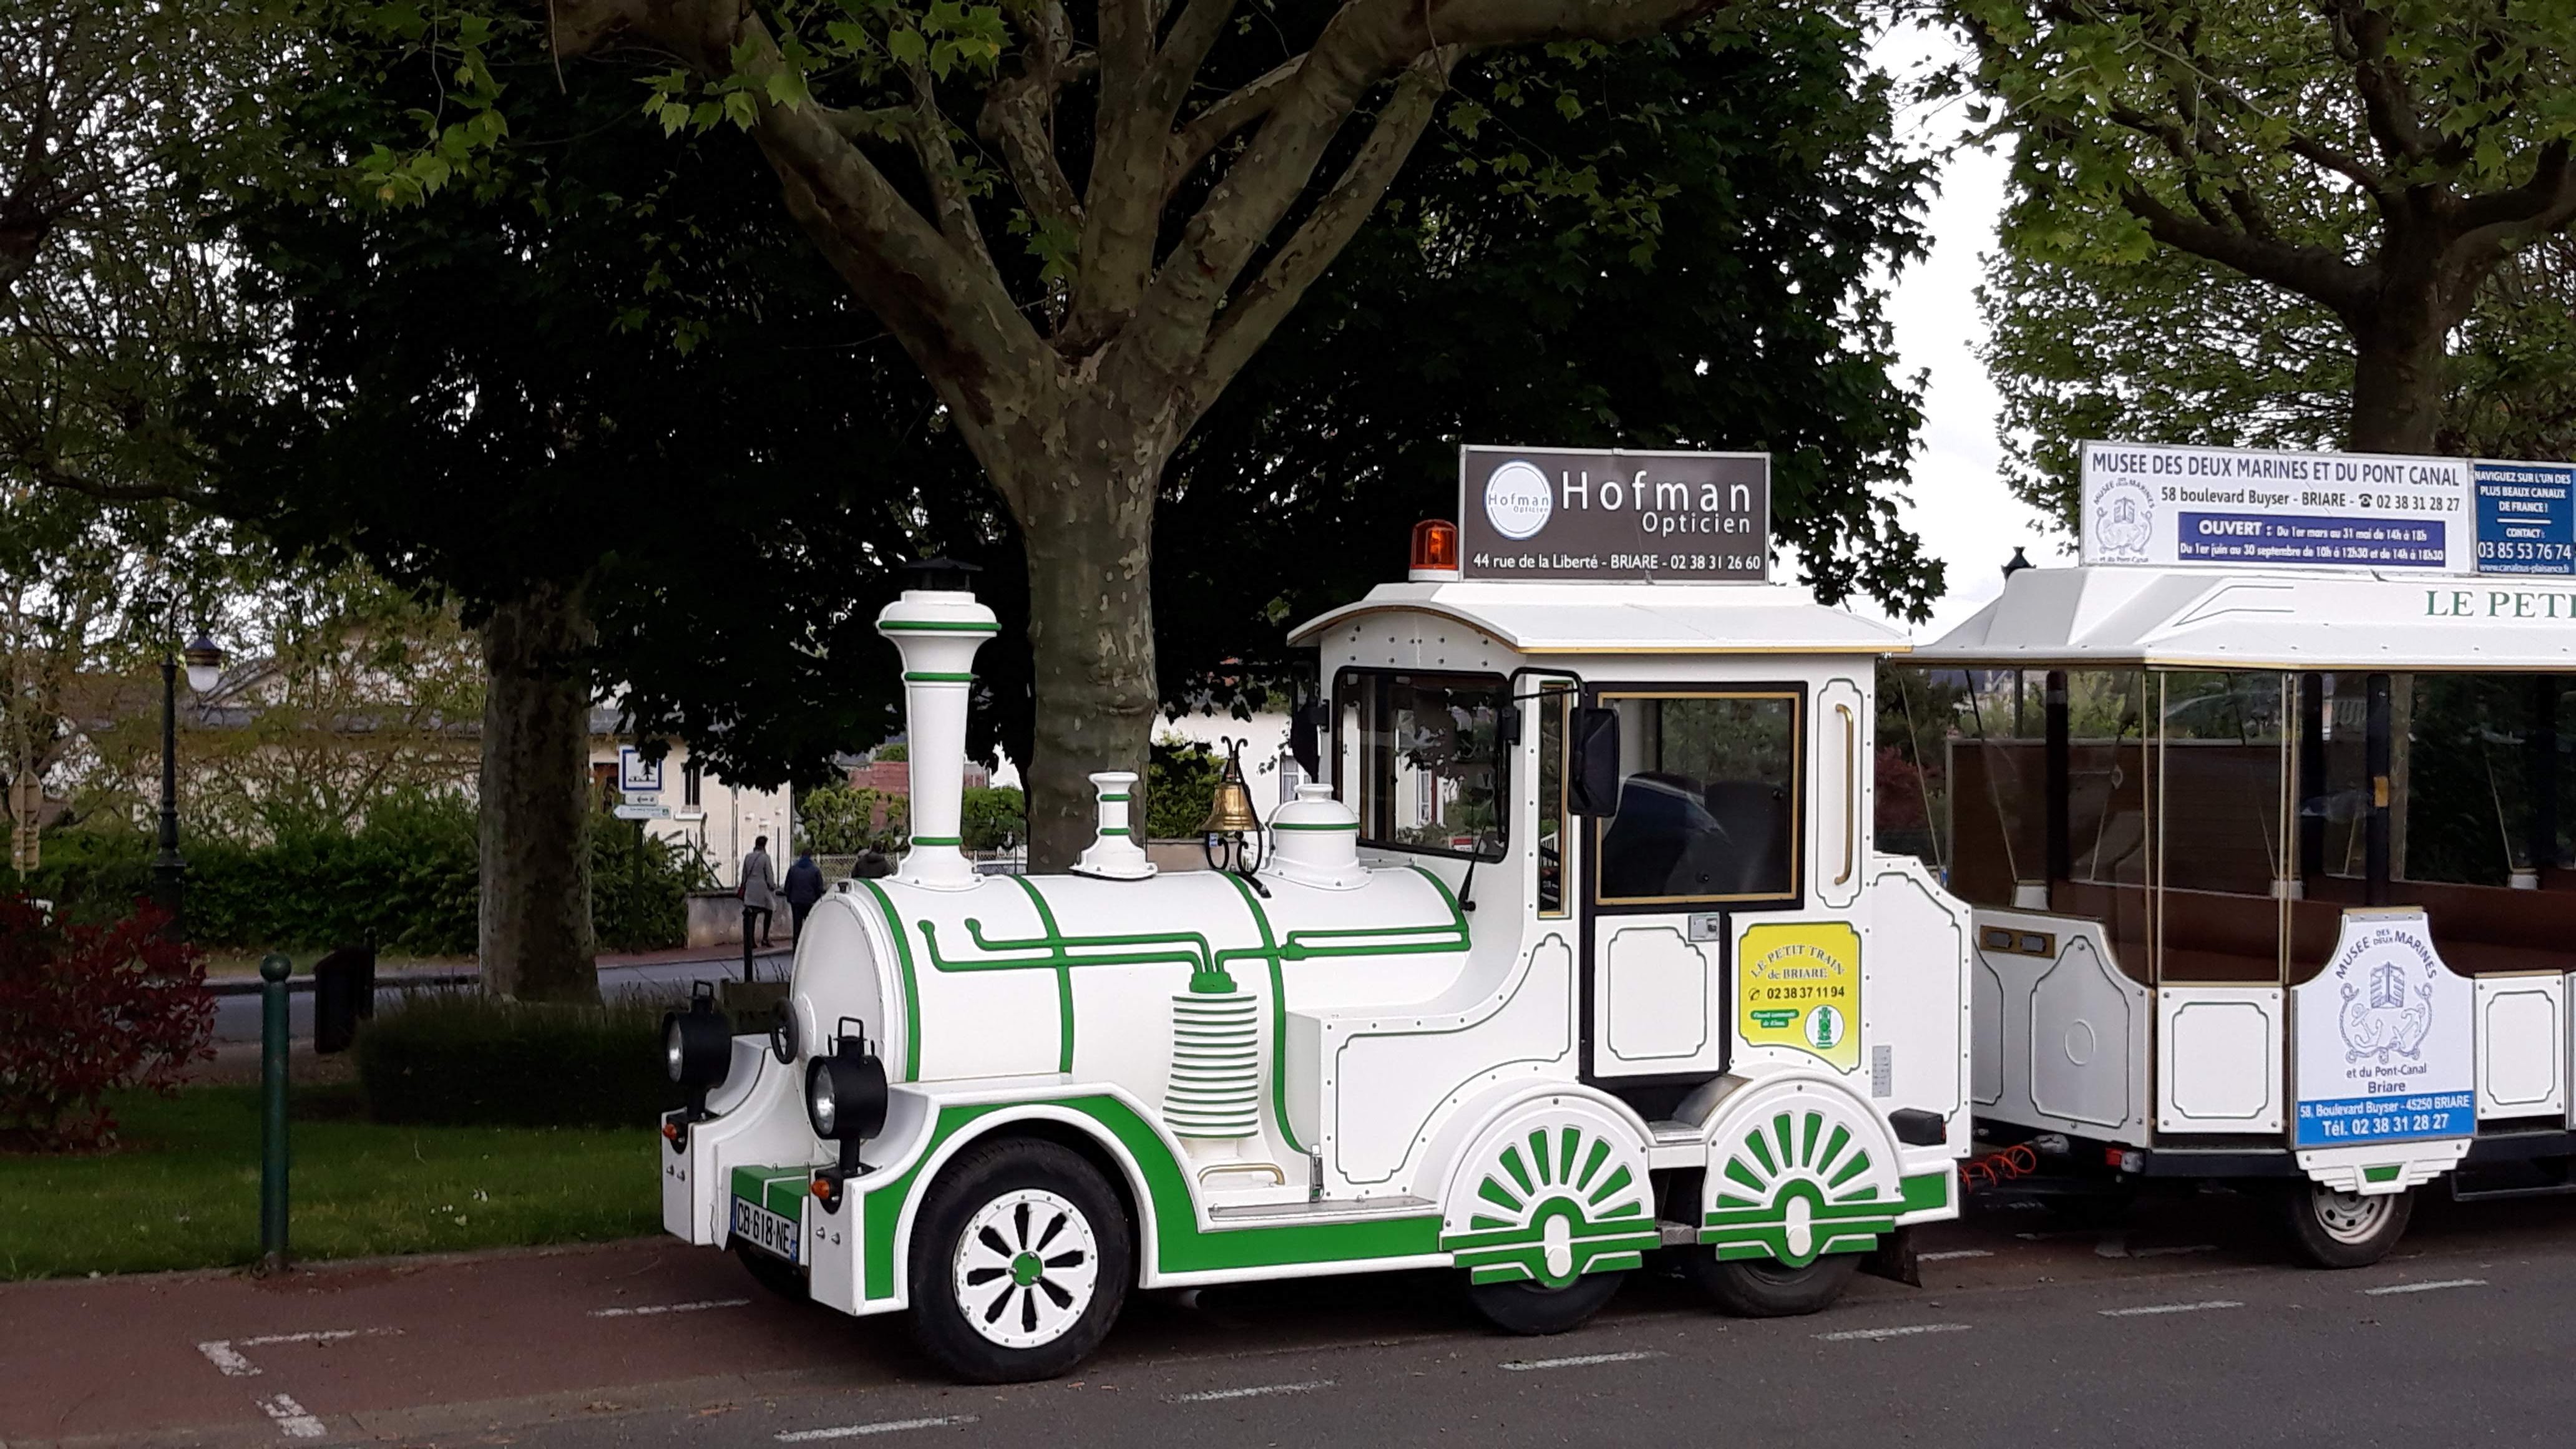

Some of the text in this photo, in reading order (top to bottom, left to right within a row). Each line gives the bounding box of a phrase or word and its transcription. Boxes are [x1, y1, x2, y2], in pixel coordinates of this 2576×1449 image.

[2092, 454, 2459, 486] MUSEE DES DEUX MARINES ET DU PONT CANAL
[2474, 471, 2516, 482] NAVIGUEZ
[2517, 472, 2534, 483] SUR
[2555, 474, 2571, 484] DES
[1488, 492, 1548, 506] Hofman
[1562, 470, 1750, 512] Hofman
[2162, 487, 2176, 501] 58
[2180, 487, 2244, 503] boulevard
[2248, 489, 2290, 509] Buyser
[2301, 491, 2346, 507] BRIARE
[2376, 494, 2391, 509] 02
[2395, 495, 2409, 509] 38
[2413, 496, 2426, 510] 31
[2429, 497, 2442, 511] 28
[2446, 498, 2460, 511] 27
[2480, 485, 2566, 499] PLUS BEAUX CANAUX
[2499, 501, 2510, 511] DE
[2512, 502, 2544, 512] FRANCE
[1642, 510, 1750, 538] Opticien
[2199, 519, 2263, 536] OUVERT
[2276, 525, 2289, 537] Du
[2291, 526, 2306, 537] 1er
[2343, 527, 2353, 539] 31
[2373, 527, 2384, 540] de
[2387, 529, 2402, 540] 14h
[2412, 530, 2427, 541] 18h
[2180, 542, 2193, 554] Du
[2195, 543, 2210, 554] 1er
[2211, 542, 2227, 557] juin
[2243, 544, 2255, 555] 30
[2257, 545, 2301, 559] septembre
[2303, 545, 2314, 557] de
[2316, 546, 2331, 558] 10h
[2342, 547, 2368, 559] 12h30
[2379, 547, 2391, 559] de
[2393, 548, 2408, 560] 14h
[2418, 549, 2444, 561] 18h30
[2477, 542, 2572, 560] 03 85 53 76 74
[1473, 553, 1489, 568] 44
[1493, 556, 1515, 568] rue
[1519, 554, 1535, 568] de
[1539, 554, 1549, 568] la
[1553, 554, 1598, 569] Liberté
[1610, 554, 1658, 569] BRIARE
[1671, 555, 1686, 569] 02
[1690, 555, 1705, 569] 38
[1709, 555, 1722, 569] 31
[1727, 555, 1742, 570] 26
[1745, 555, 1760, 570] 60
[2424, 590, 2474, 617] LE
[1750, 944, 1845, 978] LE PETIT TRAIN
[2336, 936, 2369, 980] MUSEE
[2376, 929, 2390, 937] DES
[2394, 930, 2437, 979] MARINES
[1768, 968, 1828, 980] de BRIARE
[1767, 985, 1845, 999] 02 38 37 11 94
[2346, 1063, 2427, 1079] et du Pont-Canal
[2368, 1081, 2406, 1093] Briare
[2316, 1103, 2364, 1117] Boulevard
[2366, 1101, 2399, 1116] Buyser
[2406, 1097, 2432, 1111] 45250
[2434, 1095, 2471, 1110] BRIARE
[2322, 1113, 2449, 1137] Tél. 02 38 31 28 27
[737, 1202, 790, 1254] CB-618-NE
